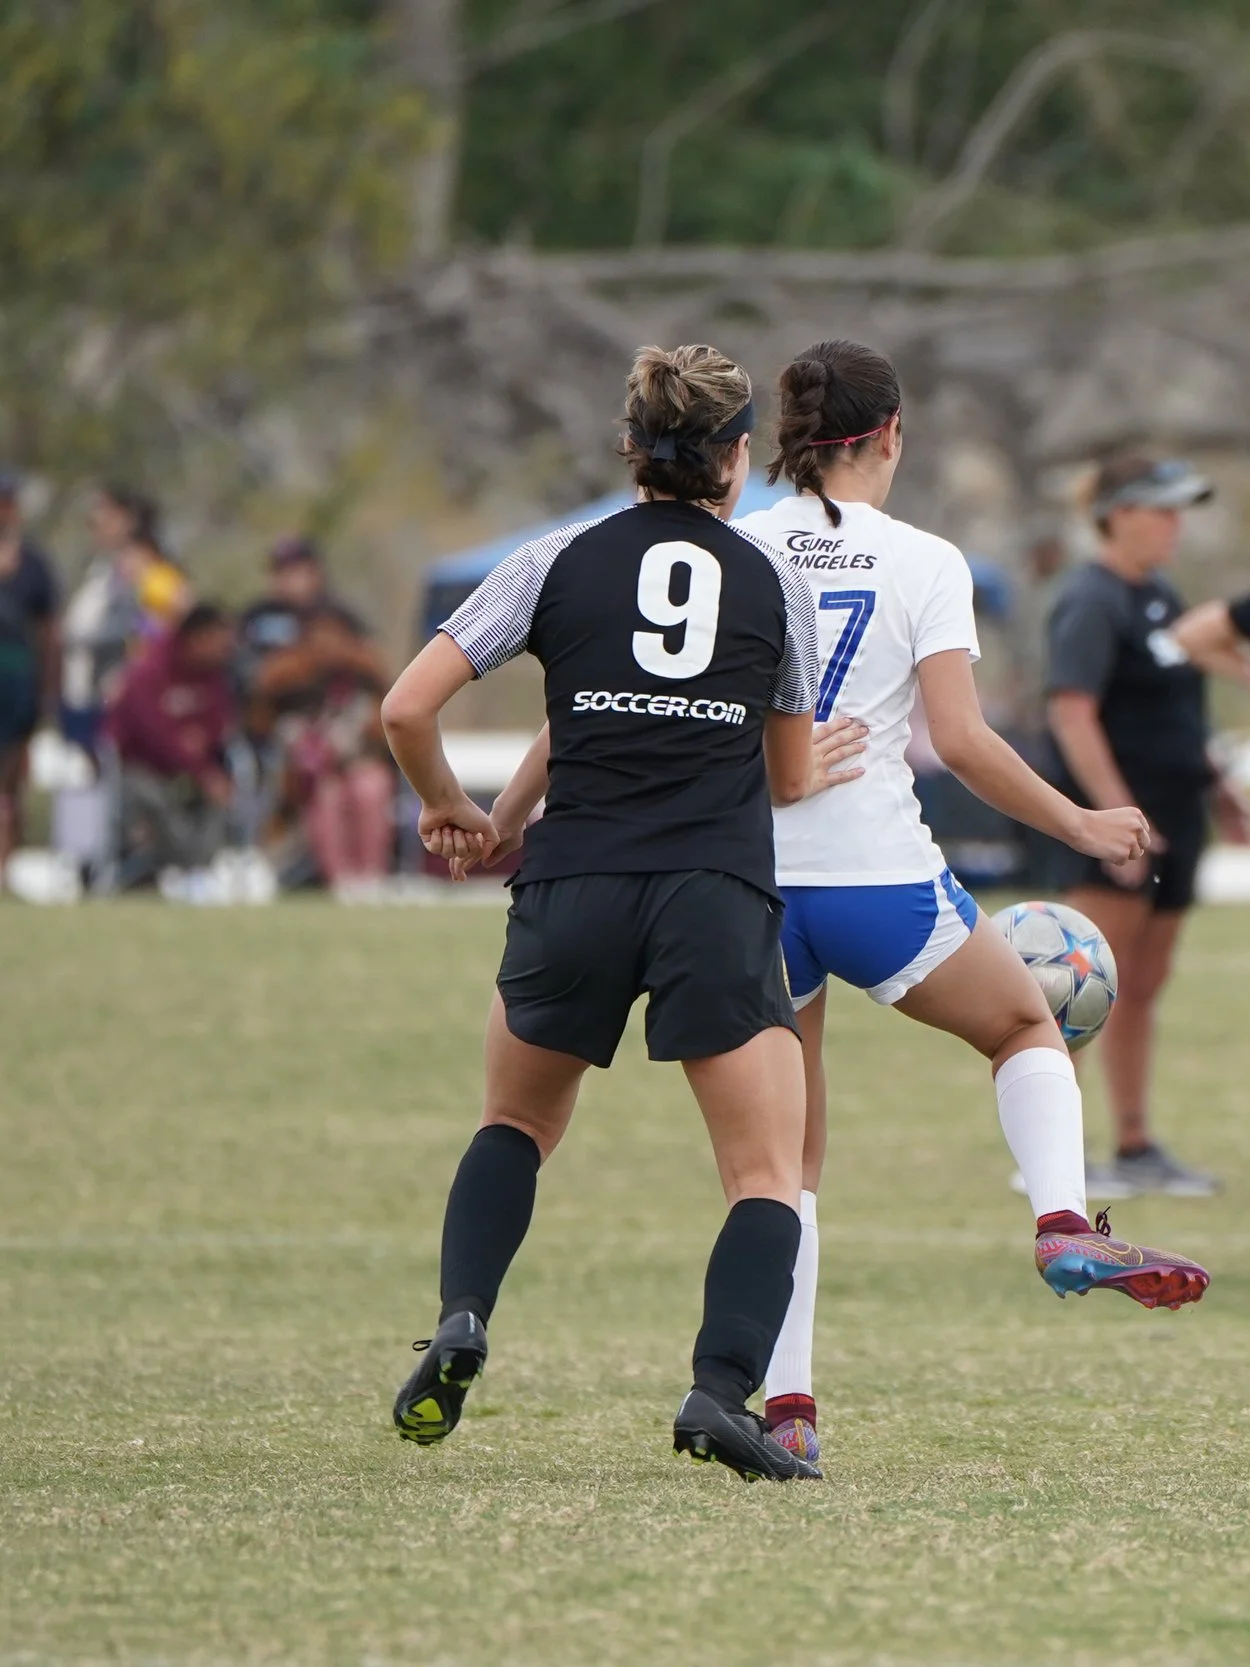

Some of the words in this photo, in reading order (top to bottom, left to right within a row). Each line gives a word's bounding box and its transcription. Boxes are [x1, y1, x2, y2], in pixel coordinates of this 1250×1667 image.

[778, 530, 845, 553] SURF
[789, 553, 878, 570] ANGELES
[632, 541, 722, 679] 9
[814, 590, 876, 722] 7
[572, 691, 747, 725] SOCCER.COM
